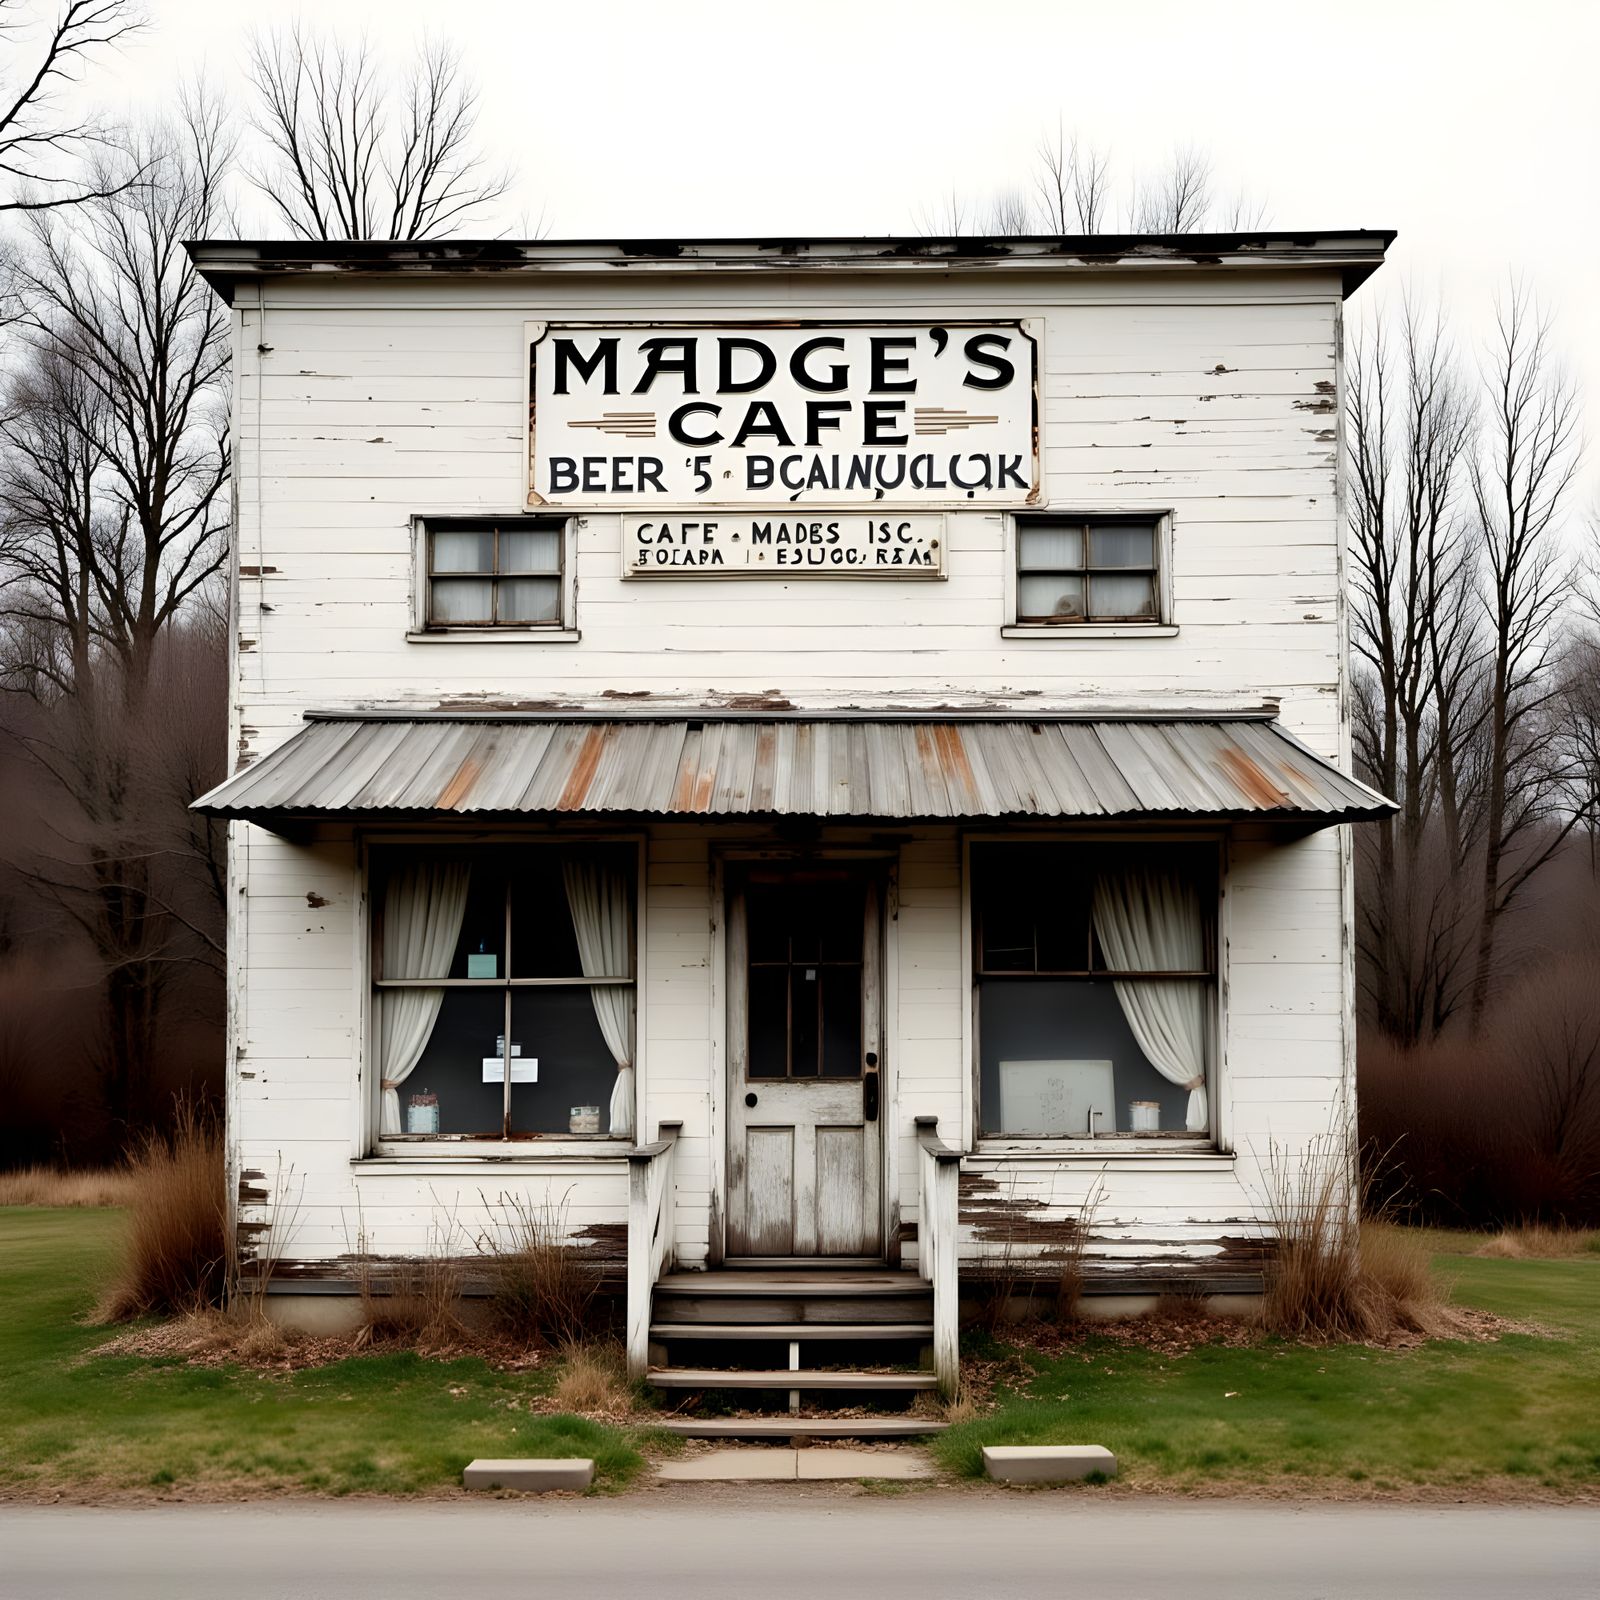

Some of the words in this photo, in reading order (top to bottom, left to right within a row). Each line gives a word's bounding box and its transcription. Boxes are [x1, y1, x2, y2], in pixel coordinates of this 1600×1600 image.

[551, 327, 1015, 396] MADGE'S
[668, 400, 909, 448] CAFE
[548, 456, 669, 494] BEER
